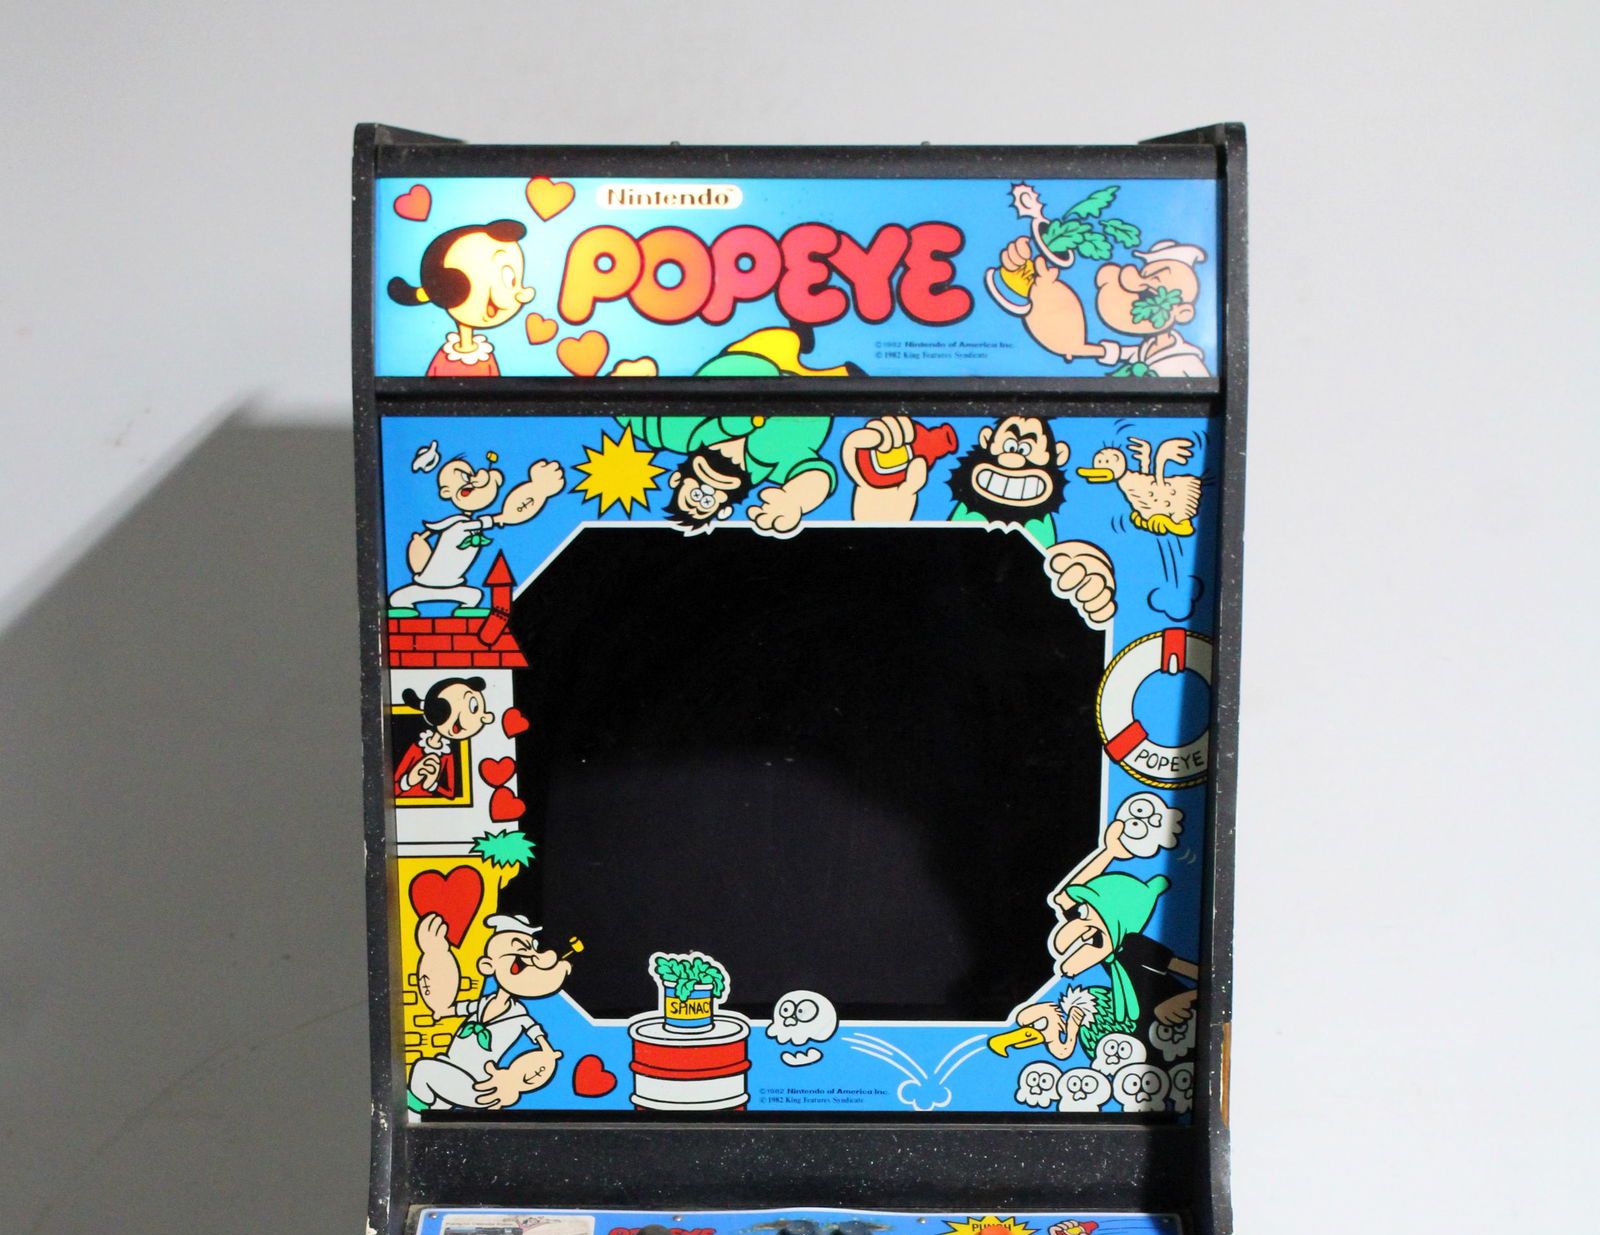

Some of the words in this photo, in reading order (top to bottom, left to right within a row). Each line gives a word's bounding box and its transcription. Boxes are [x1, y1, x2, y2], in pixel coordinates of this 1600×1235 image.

[607, 188, 730, 206] Nintendo
[557, 221, 974, 327] POPEYE
[1134, 749, 1205, 772] POPEYE
